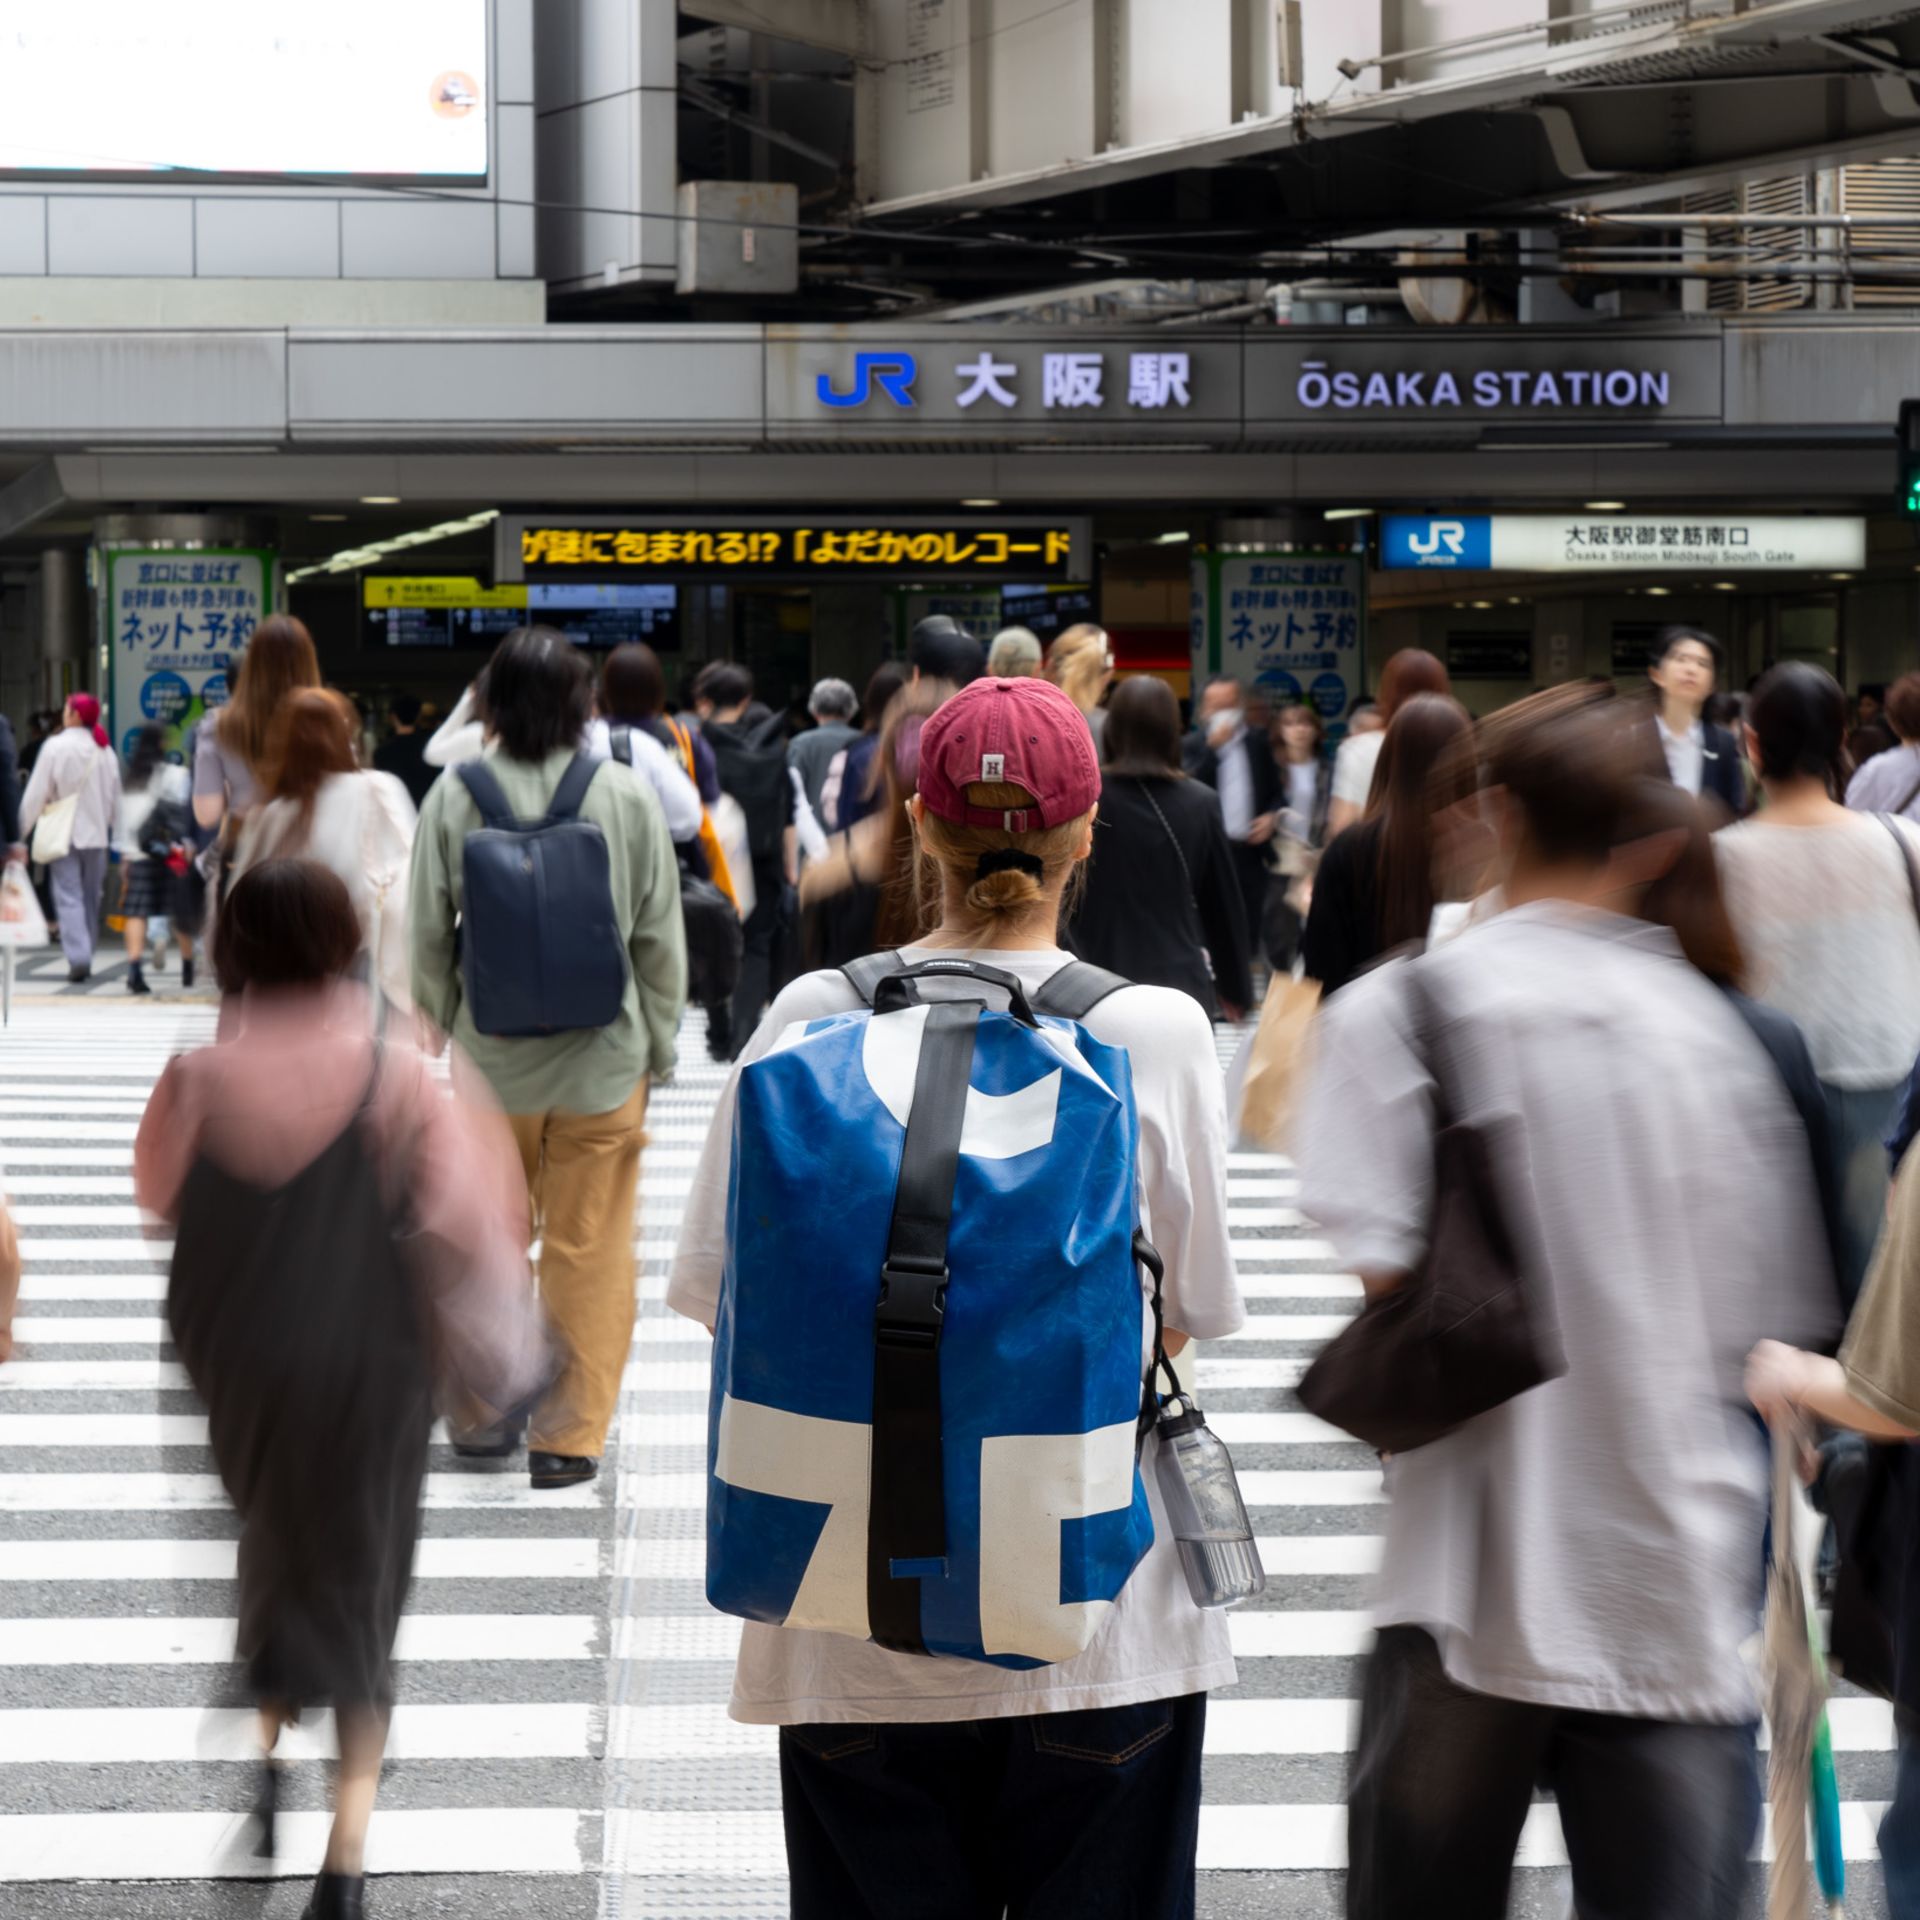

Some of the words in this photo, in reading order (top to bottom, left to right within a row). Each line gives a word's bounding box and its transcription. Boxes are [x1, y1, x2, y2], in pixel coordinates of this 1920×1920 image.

[817, 352, 917, 407] JR
[955, 352, 1191, 408] 大阪駅
[1297, 361, 1461, 408] ŌSAKA
[1472, 369, 1670, 407] STATION
[1408, 520, 1466, 555] JR
[1565, 525, 1749, 547] 大阪駅御堂筋南口
[1611, 549, 1658, 562] Station
[1722, 549, 1761, 562] South
[1764, 549, 1796, 562] Gate
[120, 612, 257, 652] ネット予約
[1228, 611, 1358, 651] ネット予約
[986, 761, 1001, 776] H
